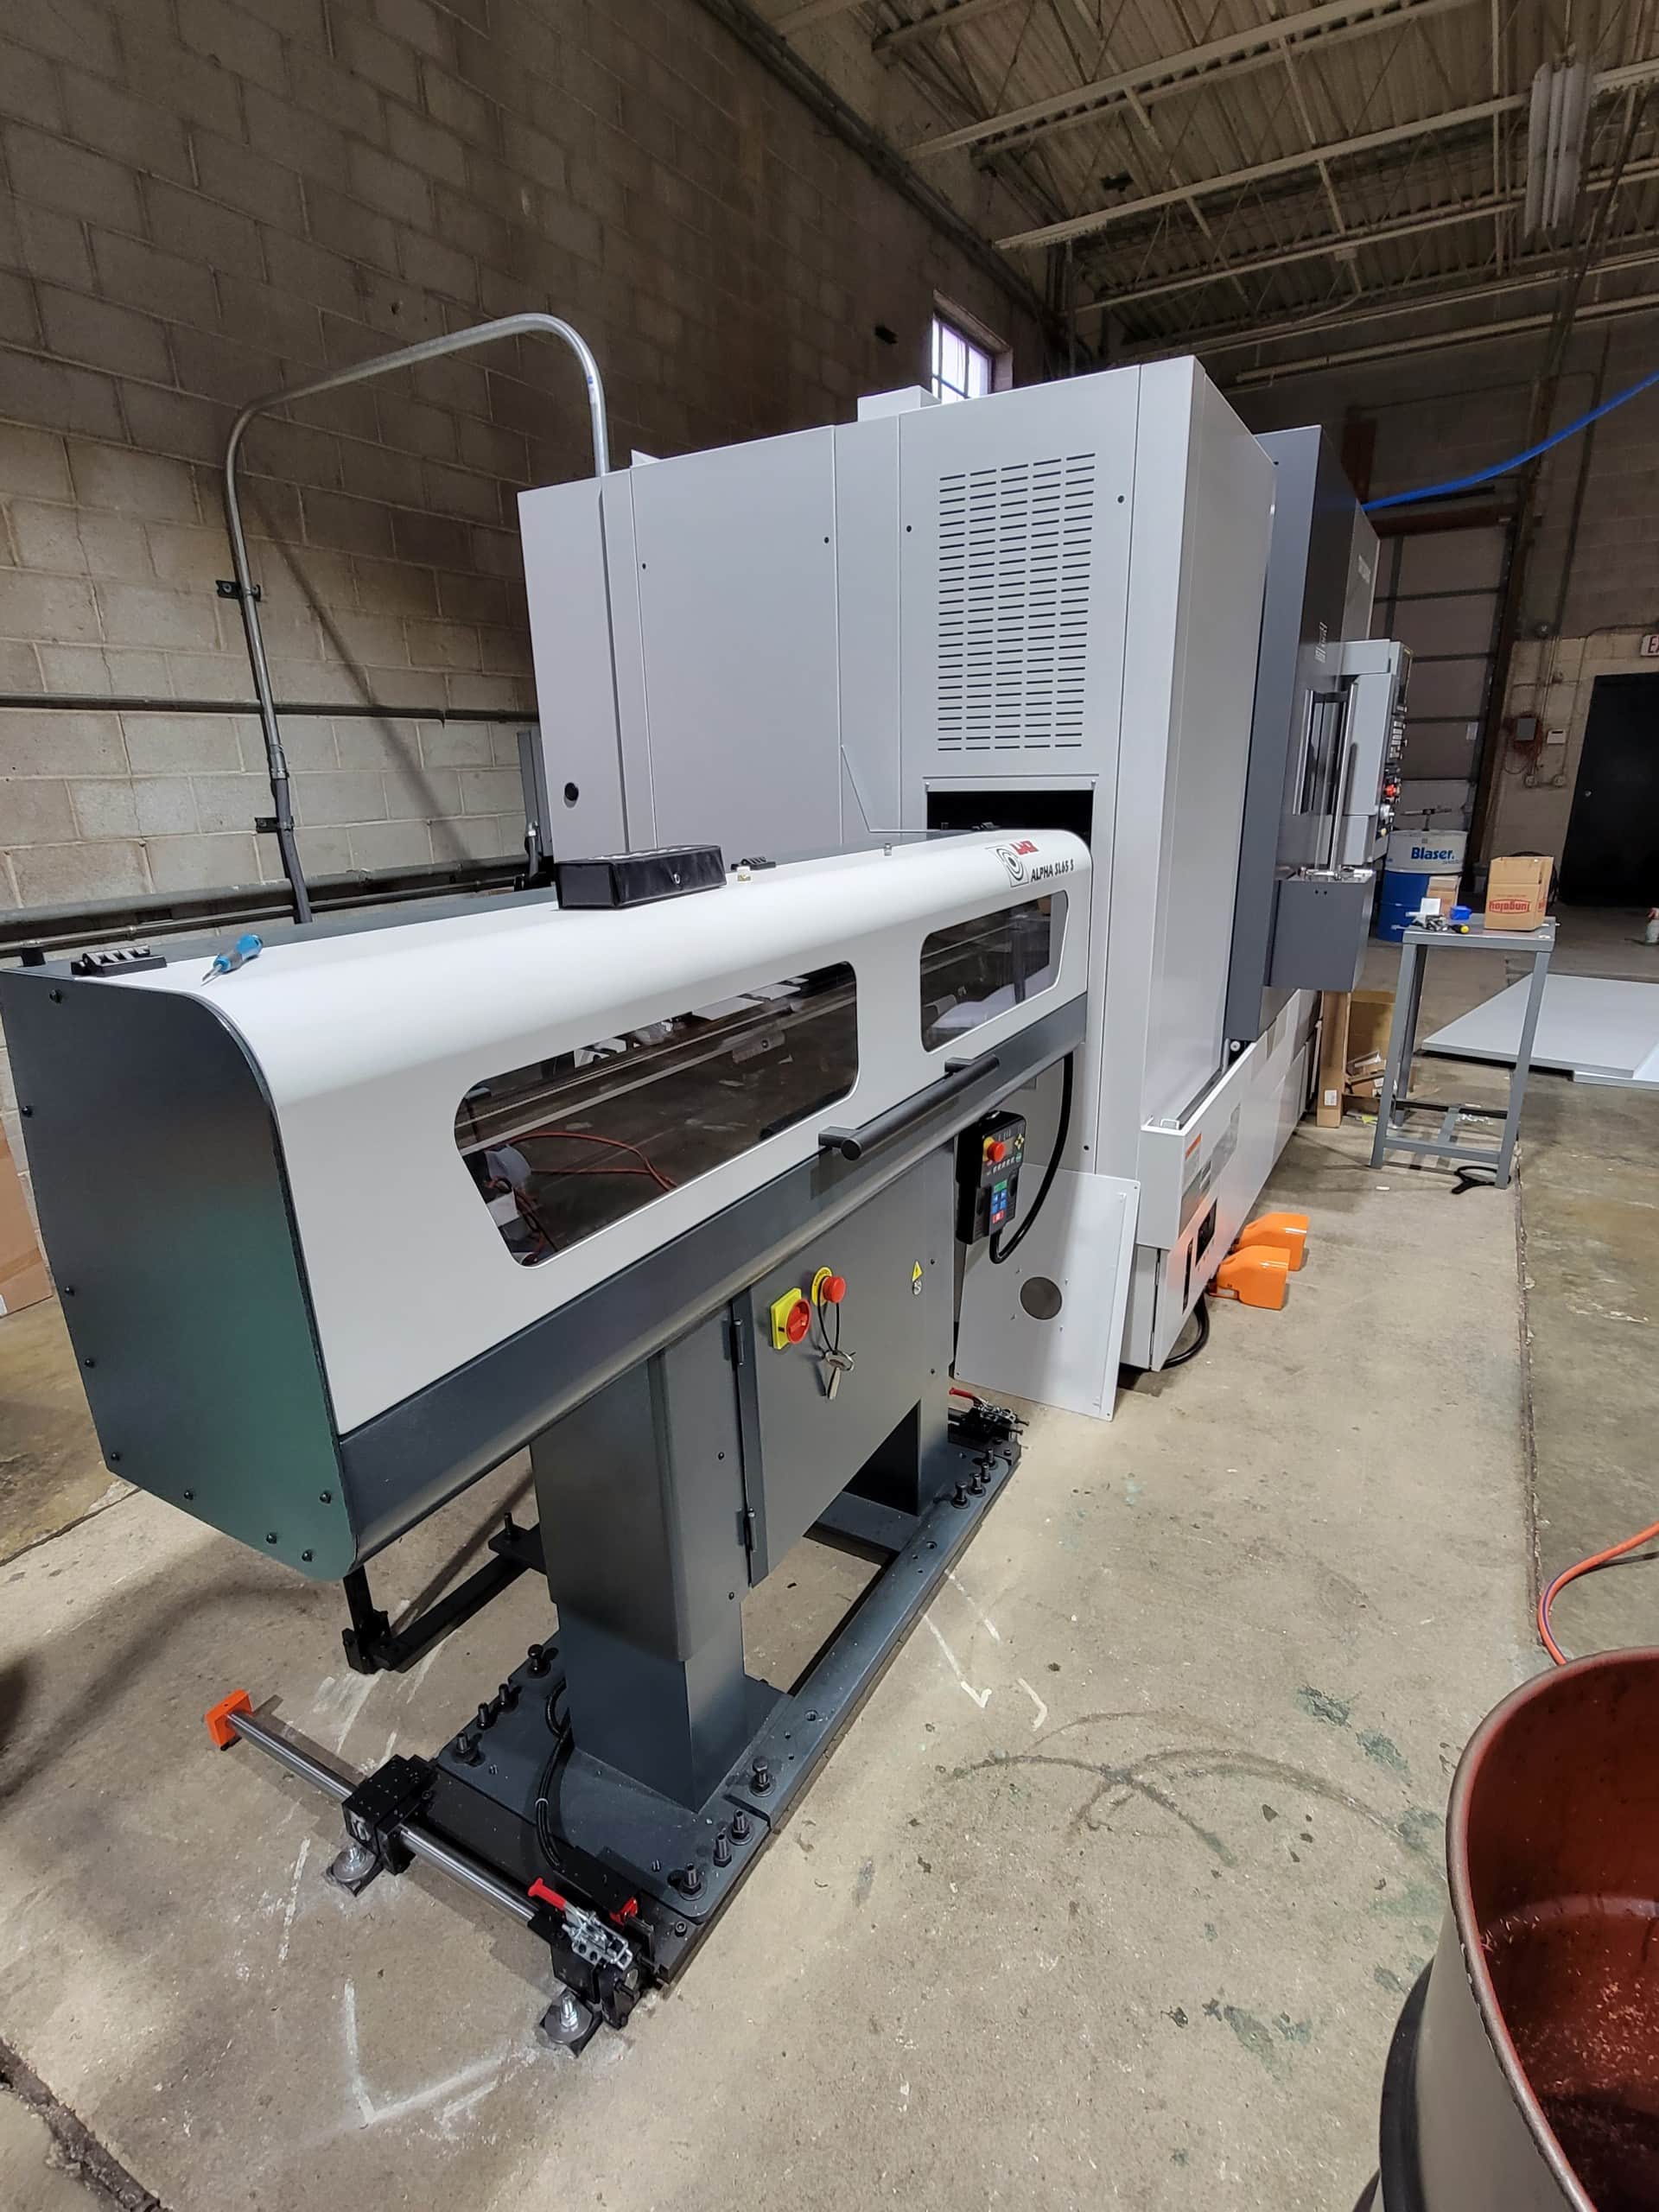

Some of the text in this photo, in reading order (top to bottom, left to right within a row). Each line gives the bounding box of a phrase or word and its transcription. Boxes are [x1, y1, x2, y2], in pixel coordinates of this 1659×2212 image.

[1030, 859, 1074, 882] ALPHA SL65 S
